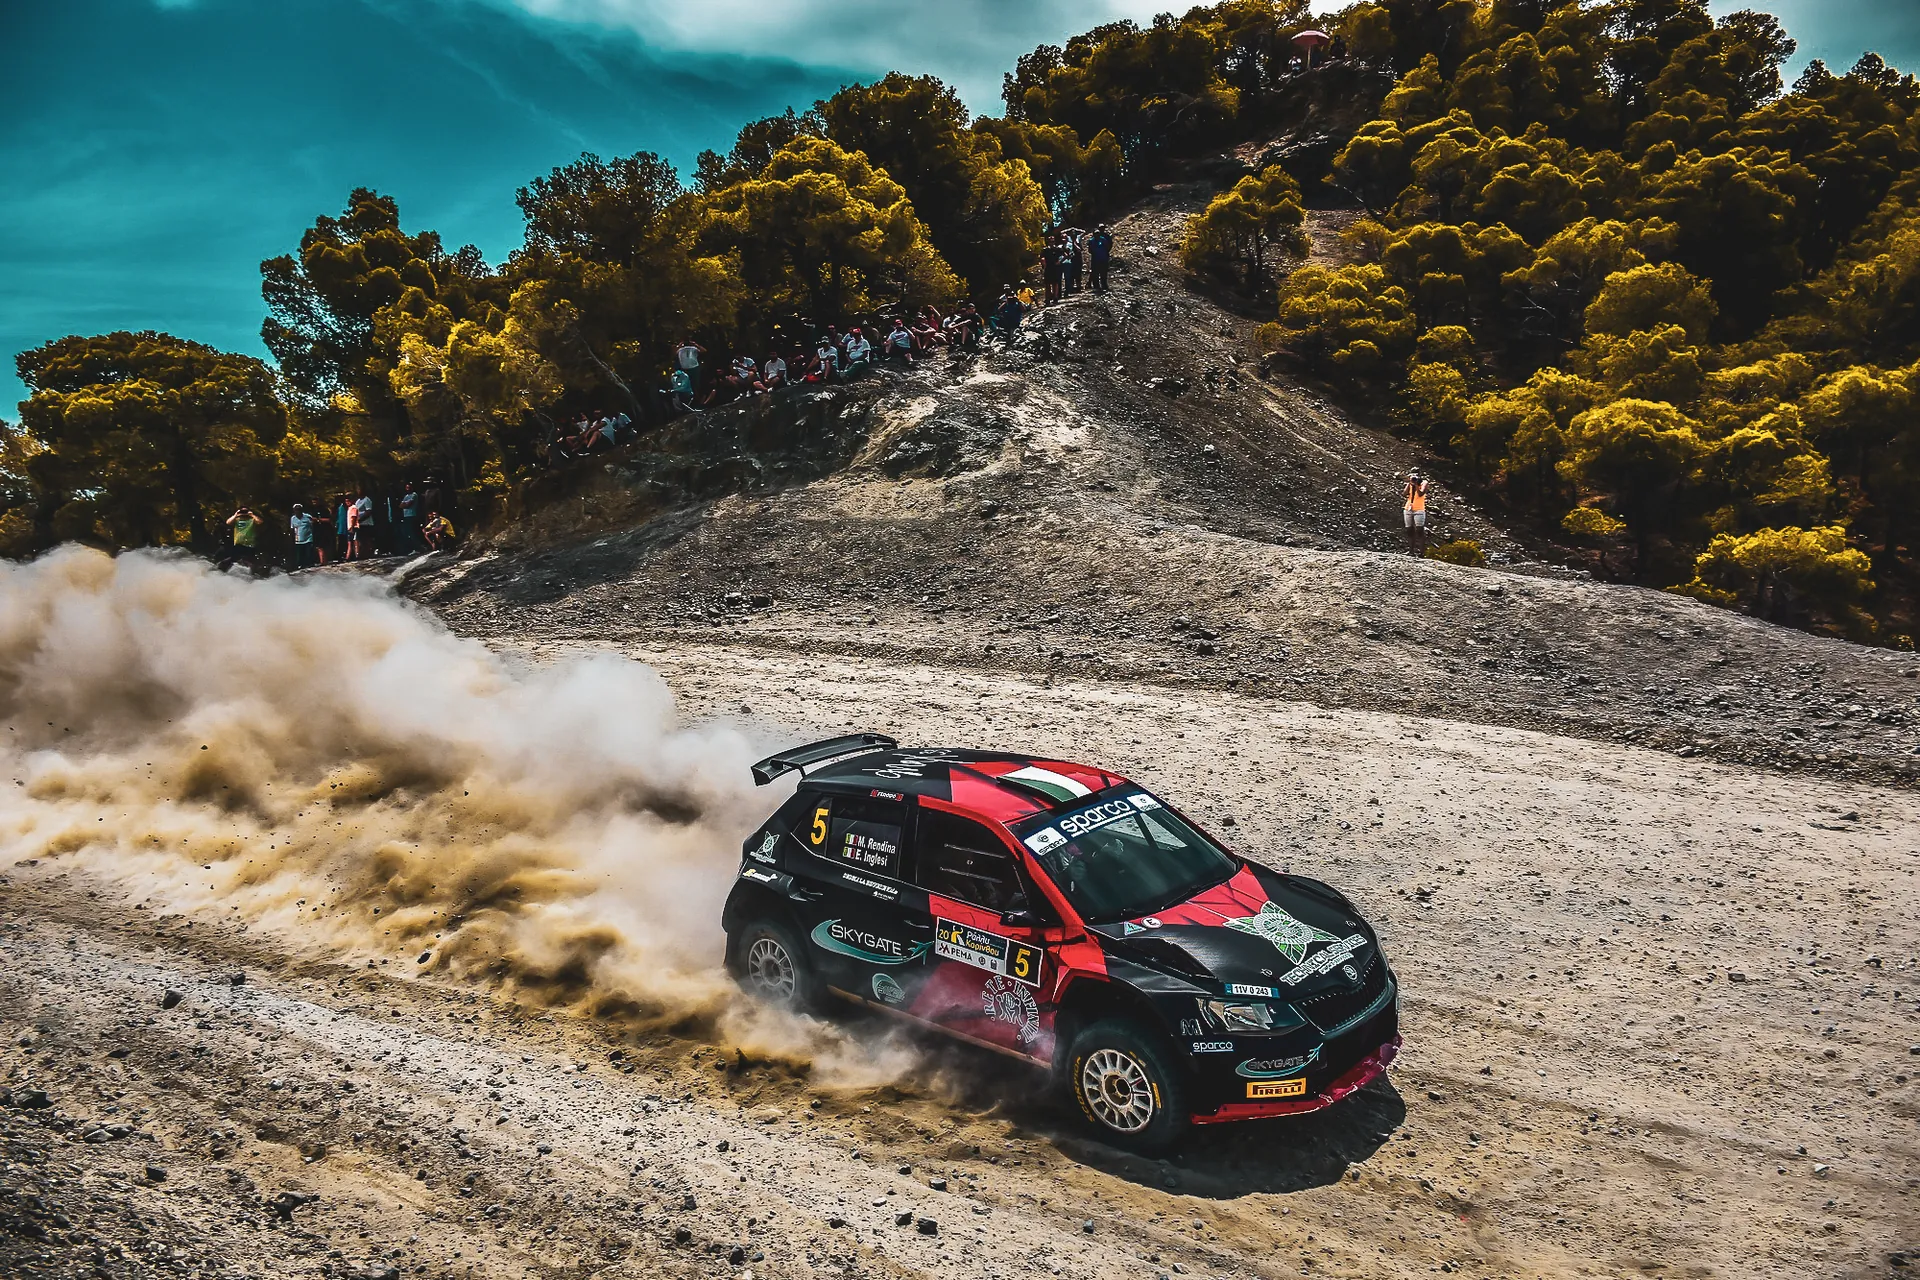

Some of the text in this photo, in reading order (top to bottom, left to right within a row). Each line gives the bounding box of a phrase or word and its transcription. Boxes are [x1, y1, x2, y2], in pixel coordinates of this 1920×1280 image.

[810, 808, 829, 845] 5
[1060, 800, 1131, 833] sparco
[855, 848, 888, 866] E. Inglesi
[857, 835, 896, 854] M. Rendina
[831, 924, 902, 956] SKYGATE
[1014, 948, 1031, 977] 5
[1279, 949, 1334, 986] TECHNICAL
[982, 975, 1006, 1016] RETE
[1192, 1041, 1234, 1052] sparco
[1248, 1055, 1304, 1070] SKYGATE
[1252, 1081, 1303, 1096] PIRELLI
